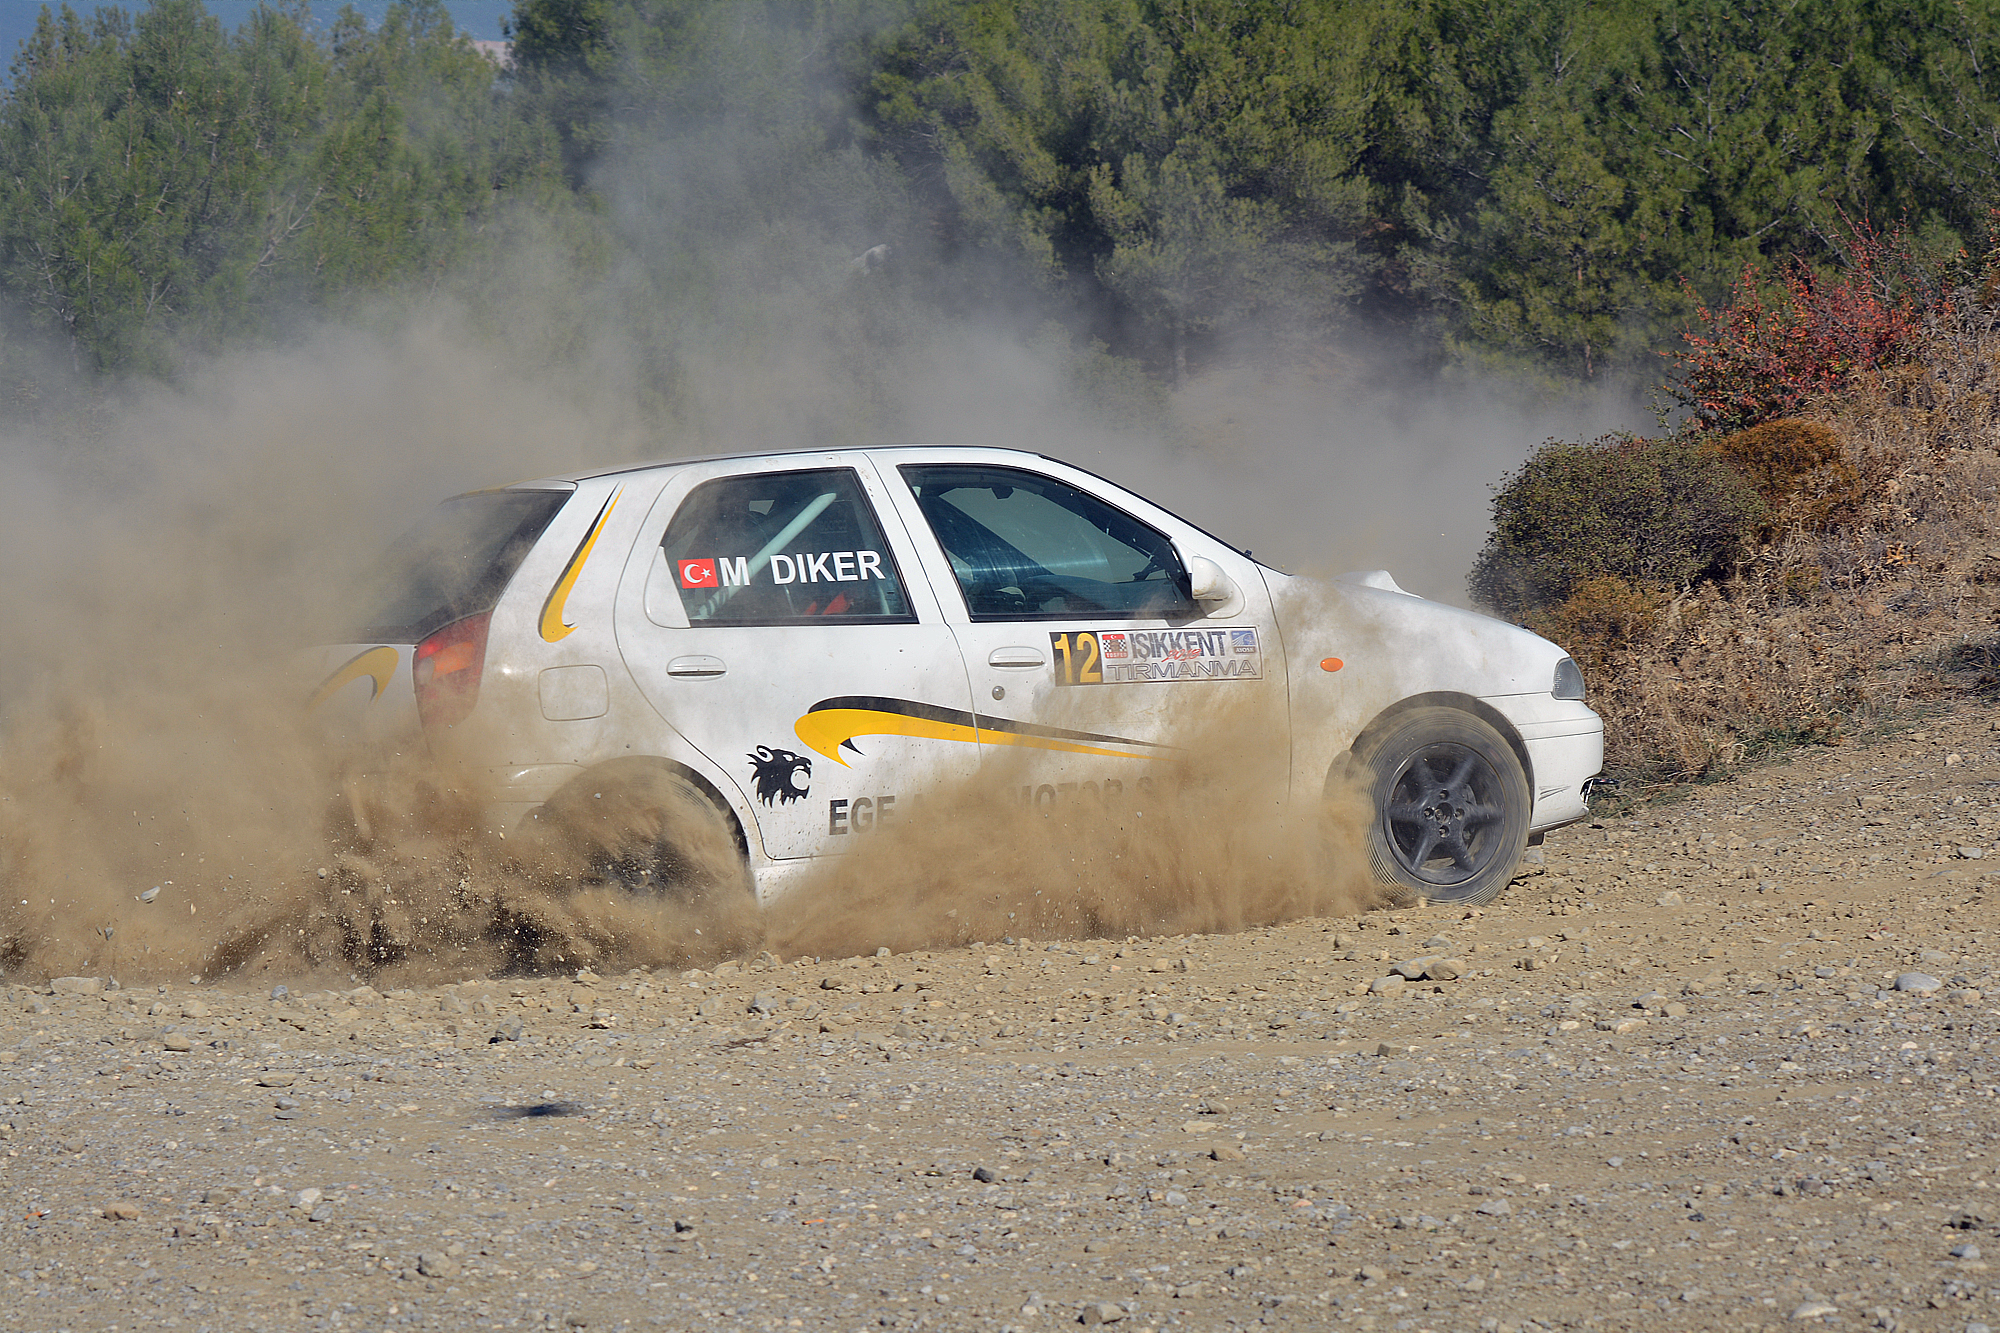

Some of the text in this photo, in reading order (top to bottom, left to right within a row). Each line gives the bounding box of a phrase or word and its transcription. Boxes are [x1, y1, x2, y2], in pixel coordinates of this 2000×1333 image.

[719, 550, 886, 587] M DIKER
[1054, 632, 1101, 684] 12
[1128, 631, 1227, 662] IŞIKKENT
[1106, 660, 1257, 681] TIRMANMA
[828, 795, 896, 836] EGE
